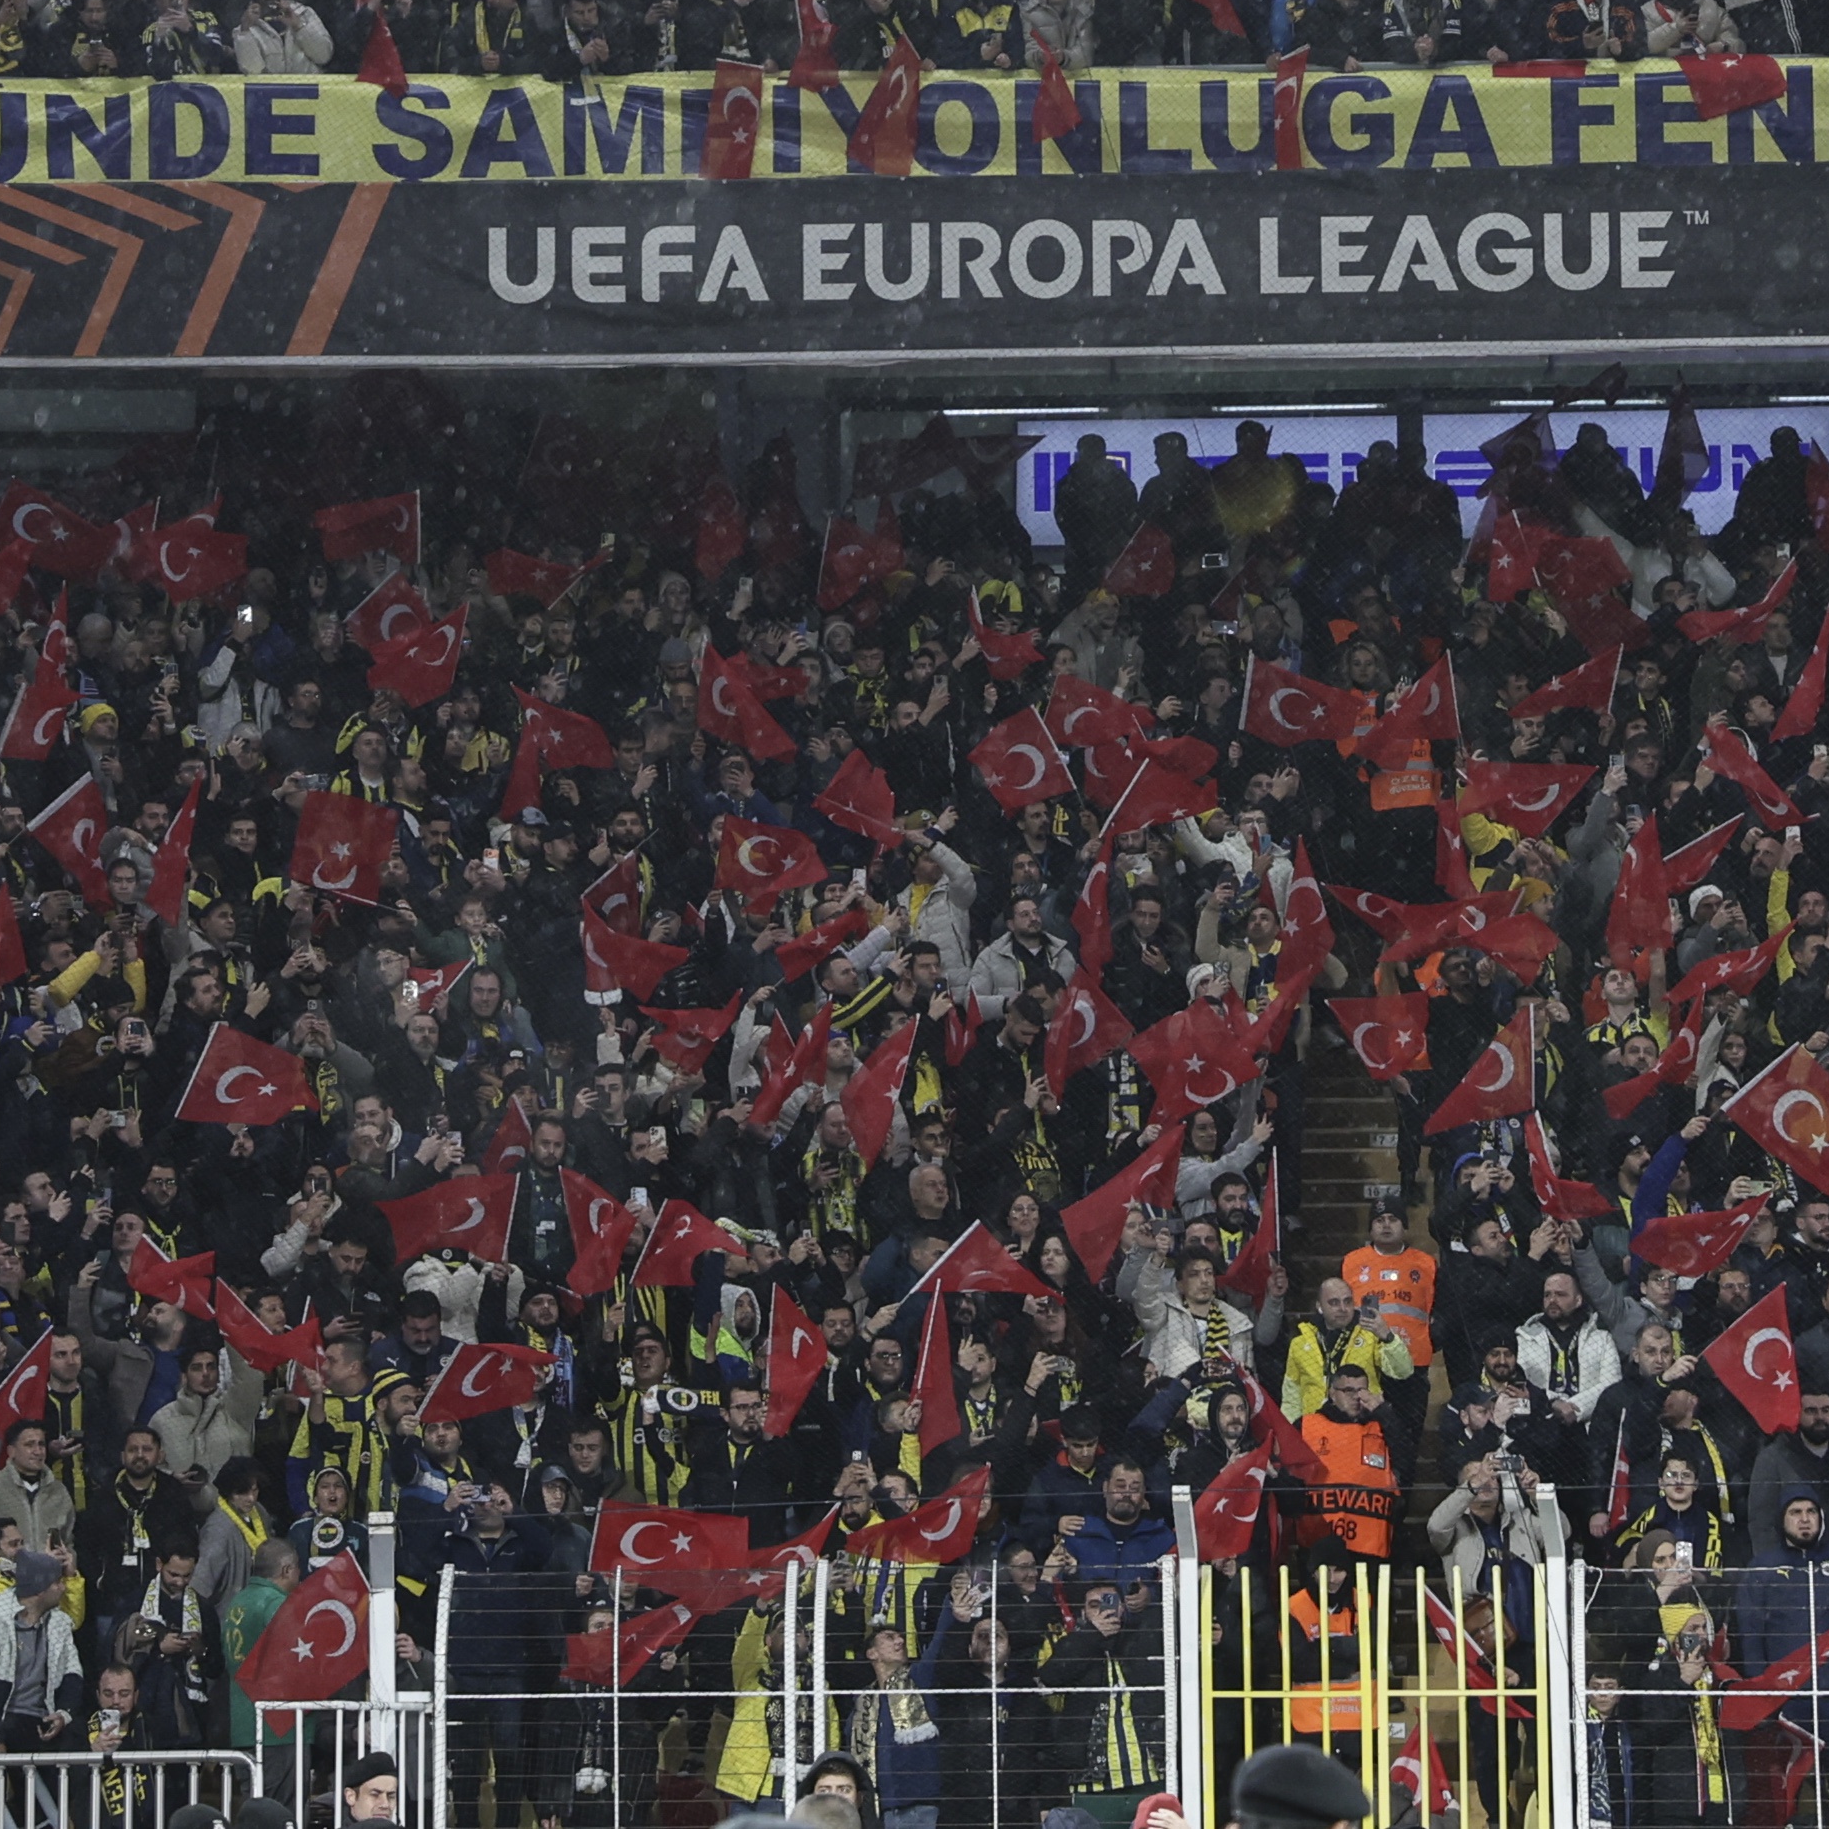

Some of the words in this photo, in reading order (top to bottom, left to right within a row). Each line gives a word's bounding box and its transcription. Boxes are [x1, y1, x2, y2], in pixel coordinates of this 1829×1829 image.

[487, 224, 770, 304] UEFA
[802, 217, 1228, 302] EUROPA
[1258, 210, 1678, 295] LEAGUE
[1307, 1488, 1392, 1516] TEWARD
